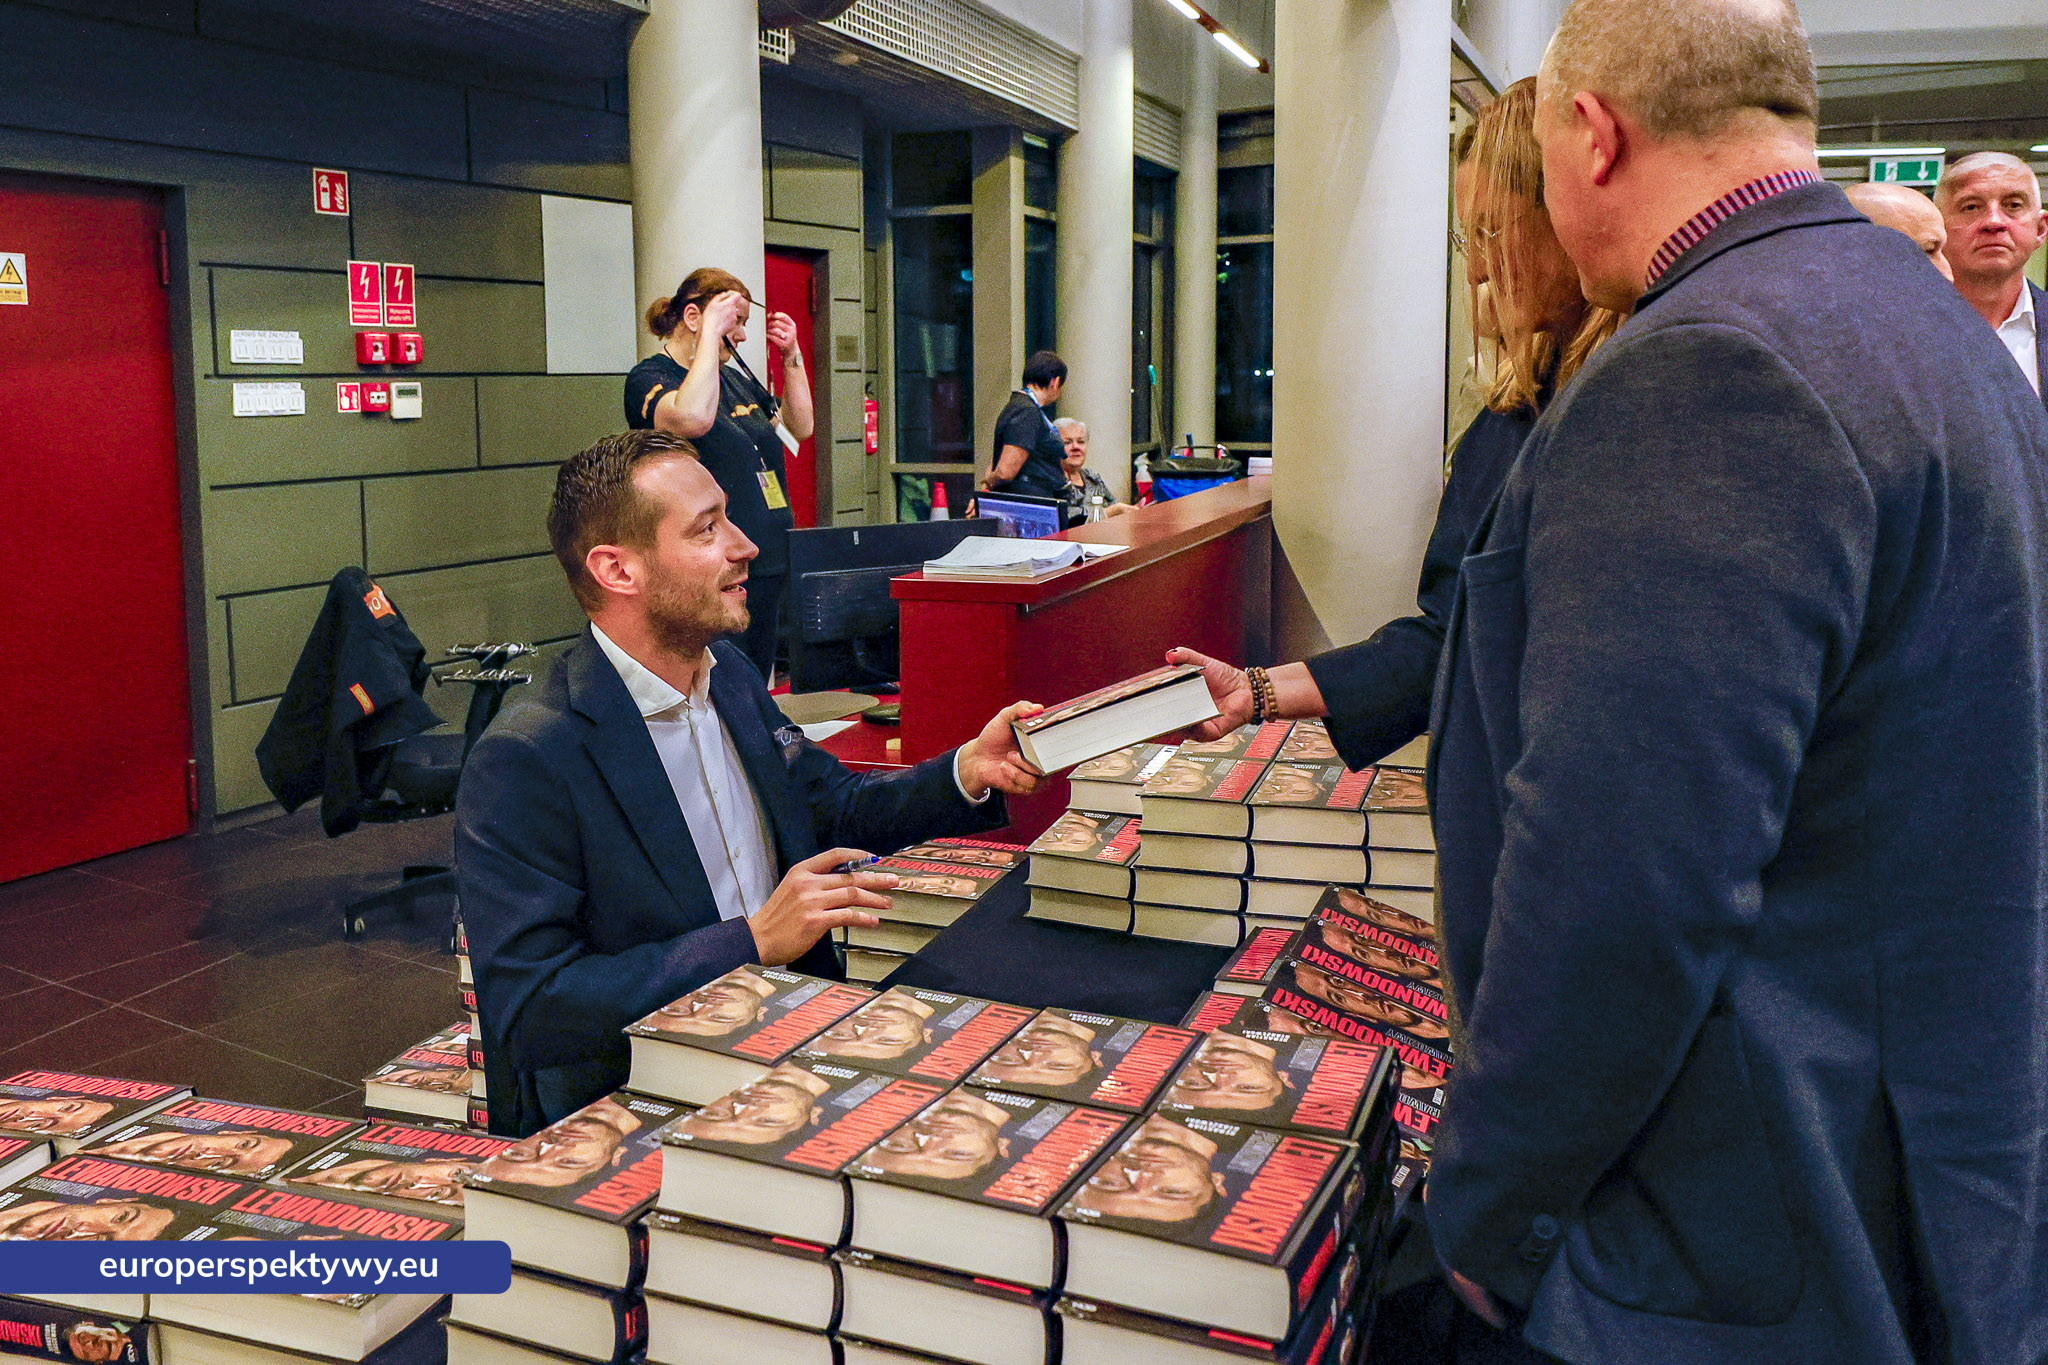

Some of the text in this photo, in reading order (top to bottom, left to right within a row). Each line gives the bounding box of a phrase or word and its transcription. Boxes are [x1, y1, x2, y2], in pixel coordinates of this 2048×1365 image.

[875, 857, 1002, 880] LEWANDOWSKI
[1320, 907, 1439, 968] ANDOWSKI
[1300, 944, 1449, 1021] WANDOWSKI
[0, 1070, 176, 1101] LEWANDOWSKI
[161, 1100, 352, 1138] LEWANDOWSKI
[356, 1125, 516, 1158] LEWANDOW
[40, 1157, 243, 1206] LEWANDOWSKI
[231, 1189, 450, 1241] LEWANDOWSKI
